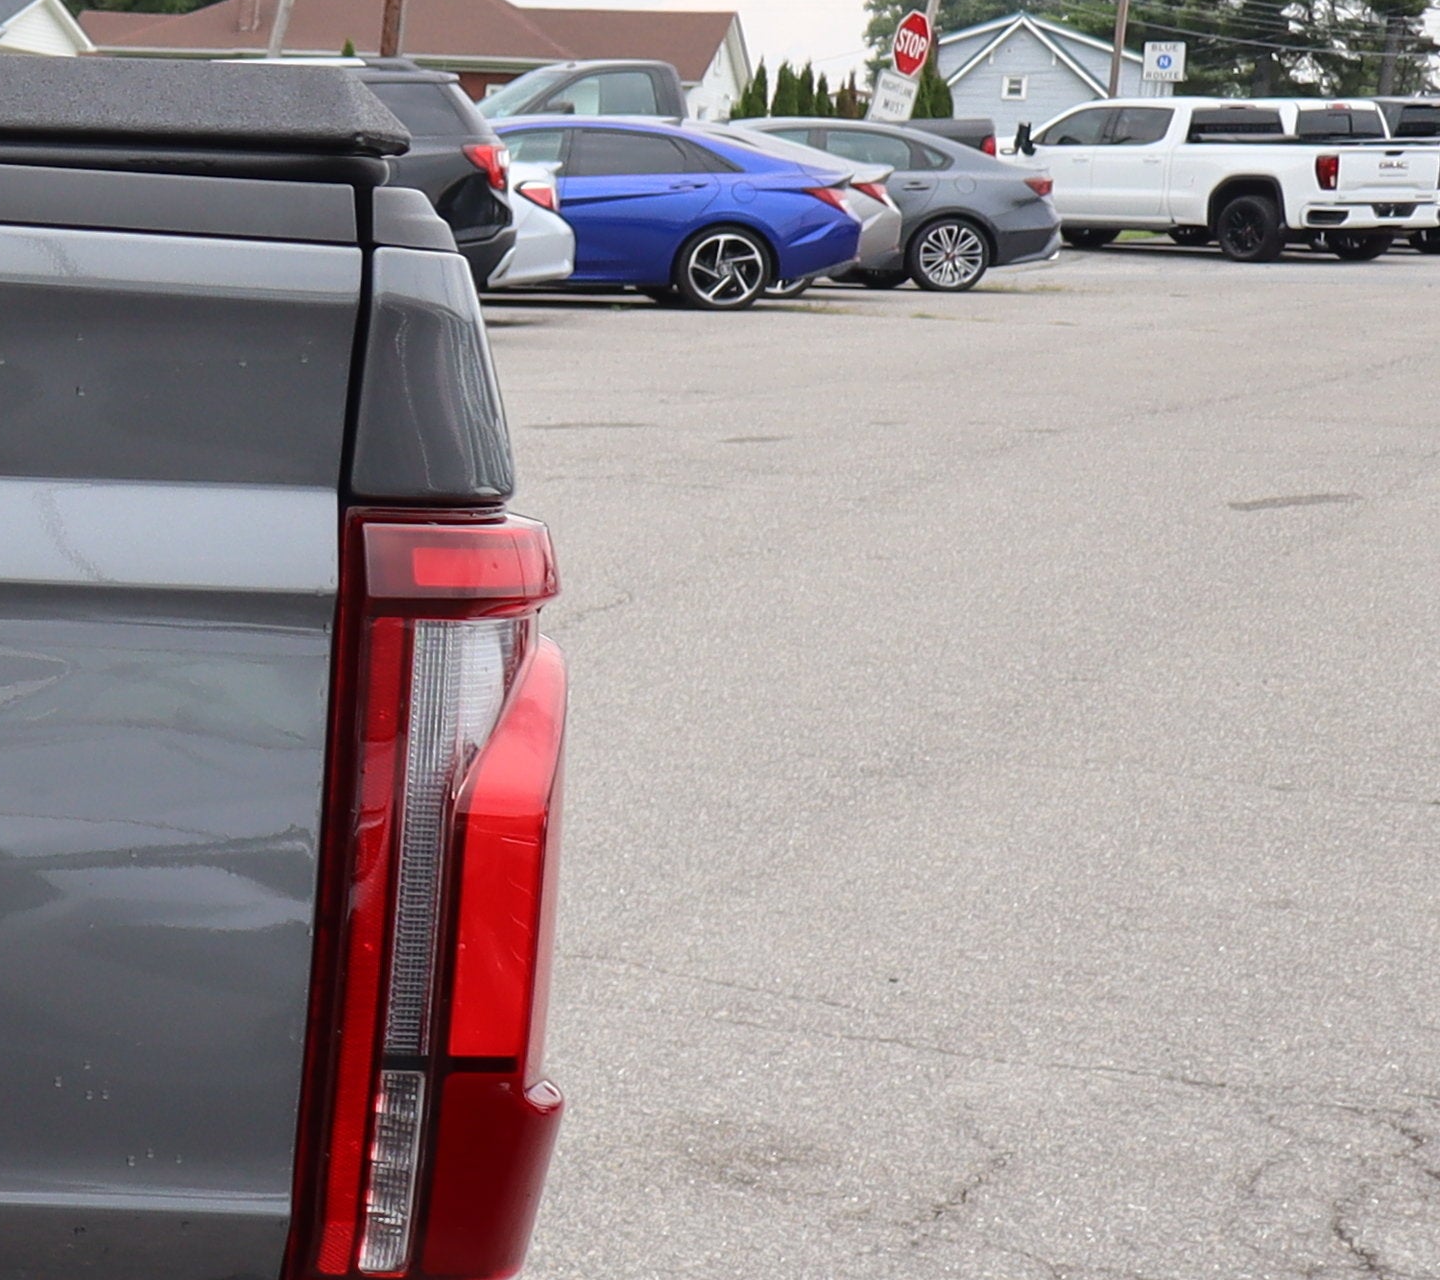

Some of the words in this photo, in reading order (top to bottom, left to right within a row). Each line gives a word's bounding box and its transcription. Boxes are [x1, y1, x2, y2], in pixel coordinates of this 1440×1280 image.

[895, 27, 928, 60] STOP
[1151, 43, 1179, 53] BLUE
[1159, 56, 1169, 67] N
[1145, 71, 1178, 79] ROUTE
